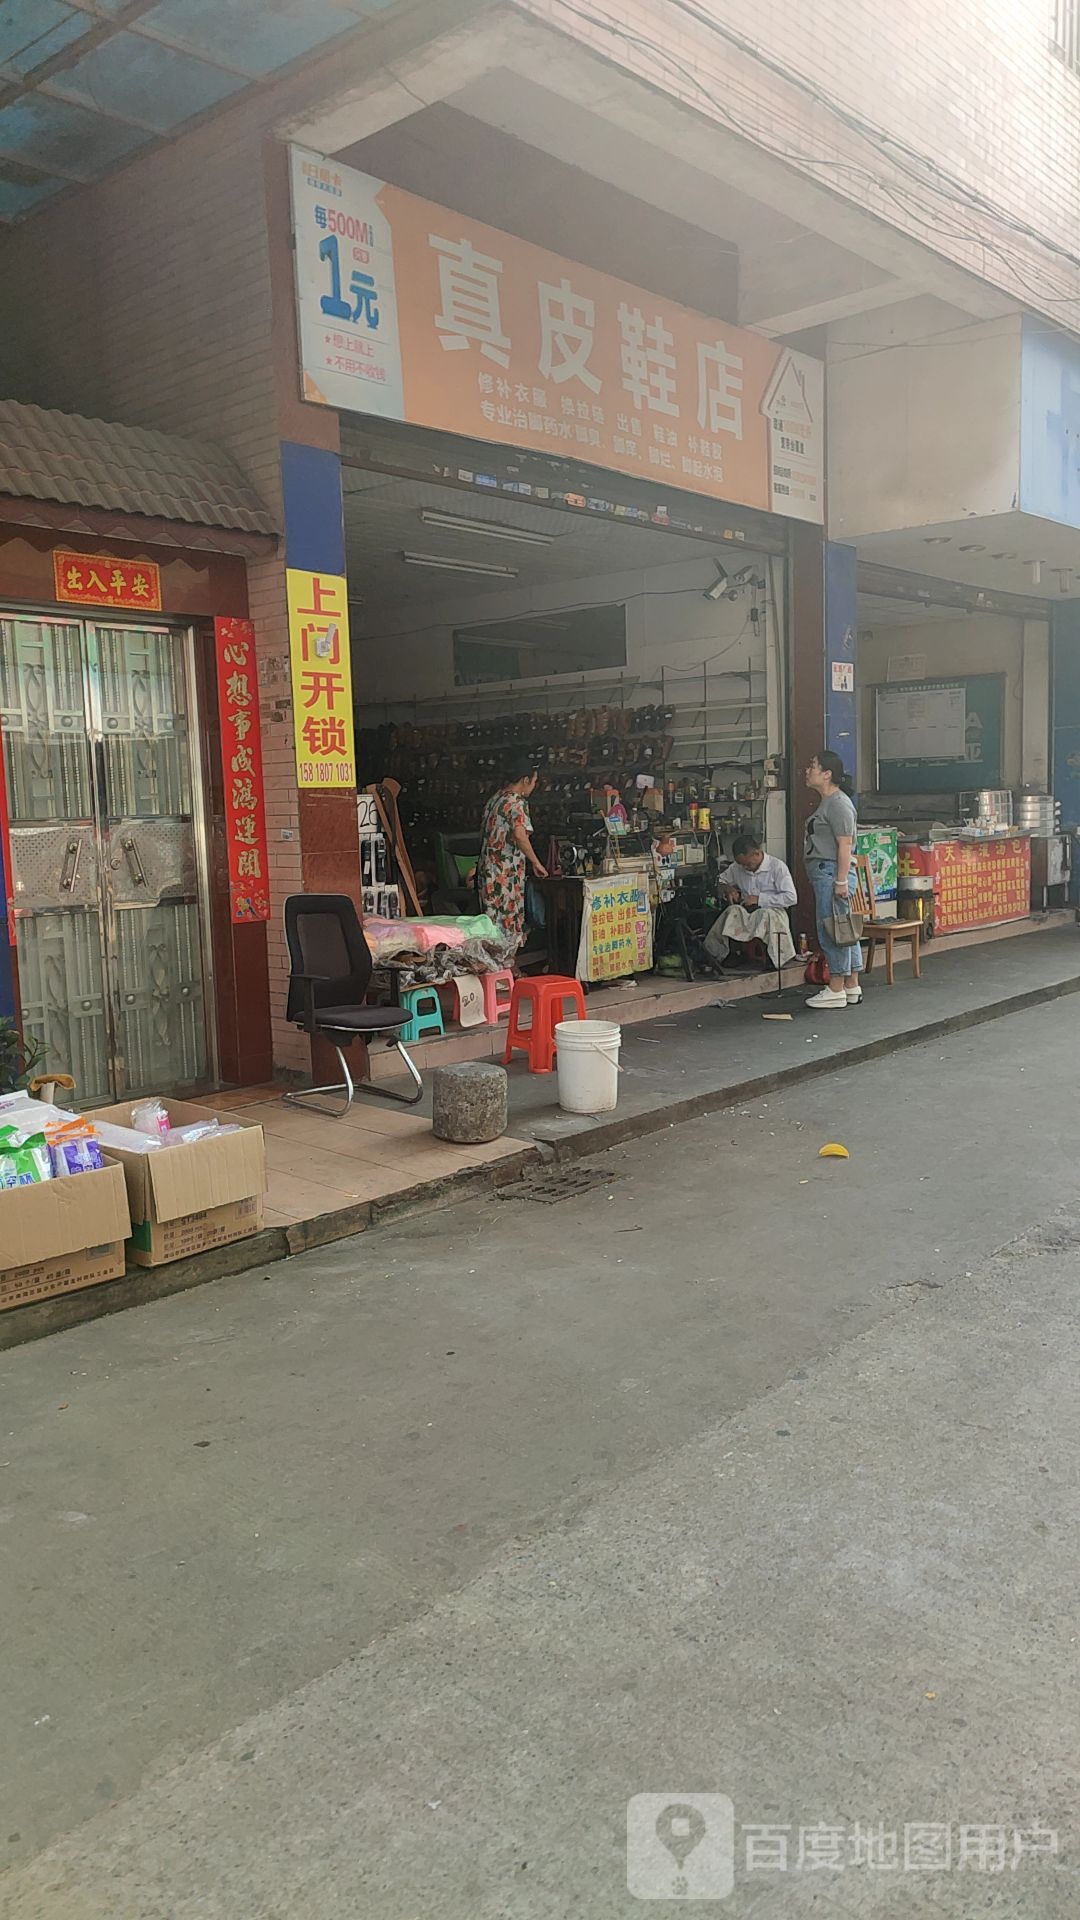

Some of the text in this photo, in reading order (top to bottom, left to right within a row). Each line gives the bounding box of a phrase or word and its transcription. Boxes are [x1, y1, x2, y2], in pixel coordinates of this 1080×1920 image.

[319, 234, 379, 330] 1元
[428, 233, 744, 442] 真皮鞋店
[66, 566, 150, 599] 出入平安
[297, 577, 348, 757] 上门开锁
[299, 761, 353, 784] 158 1807 1031
